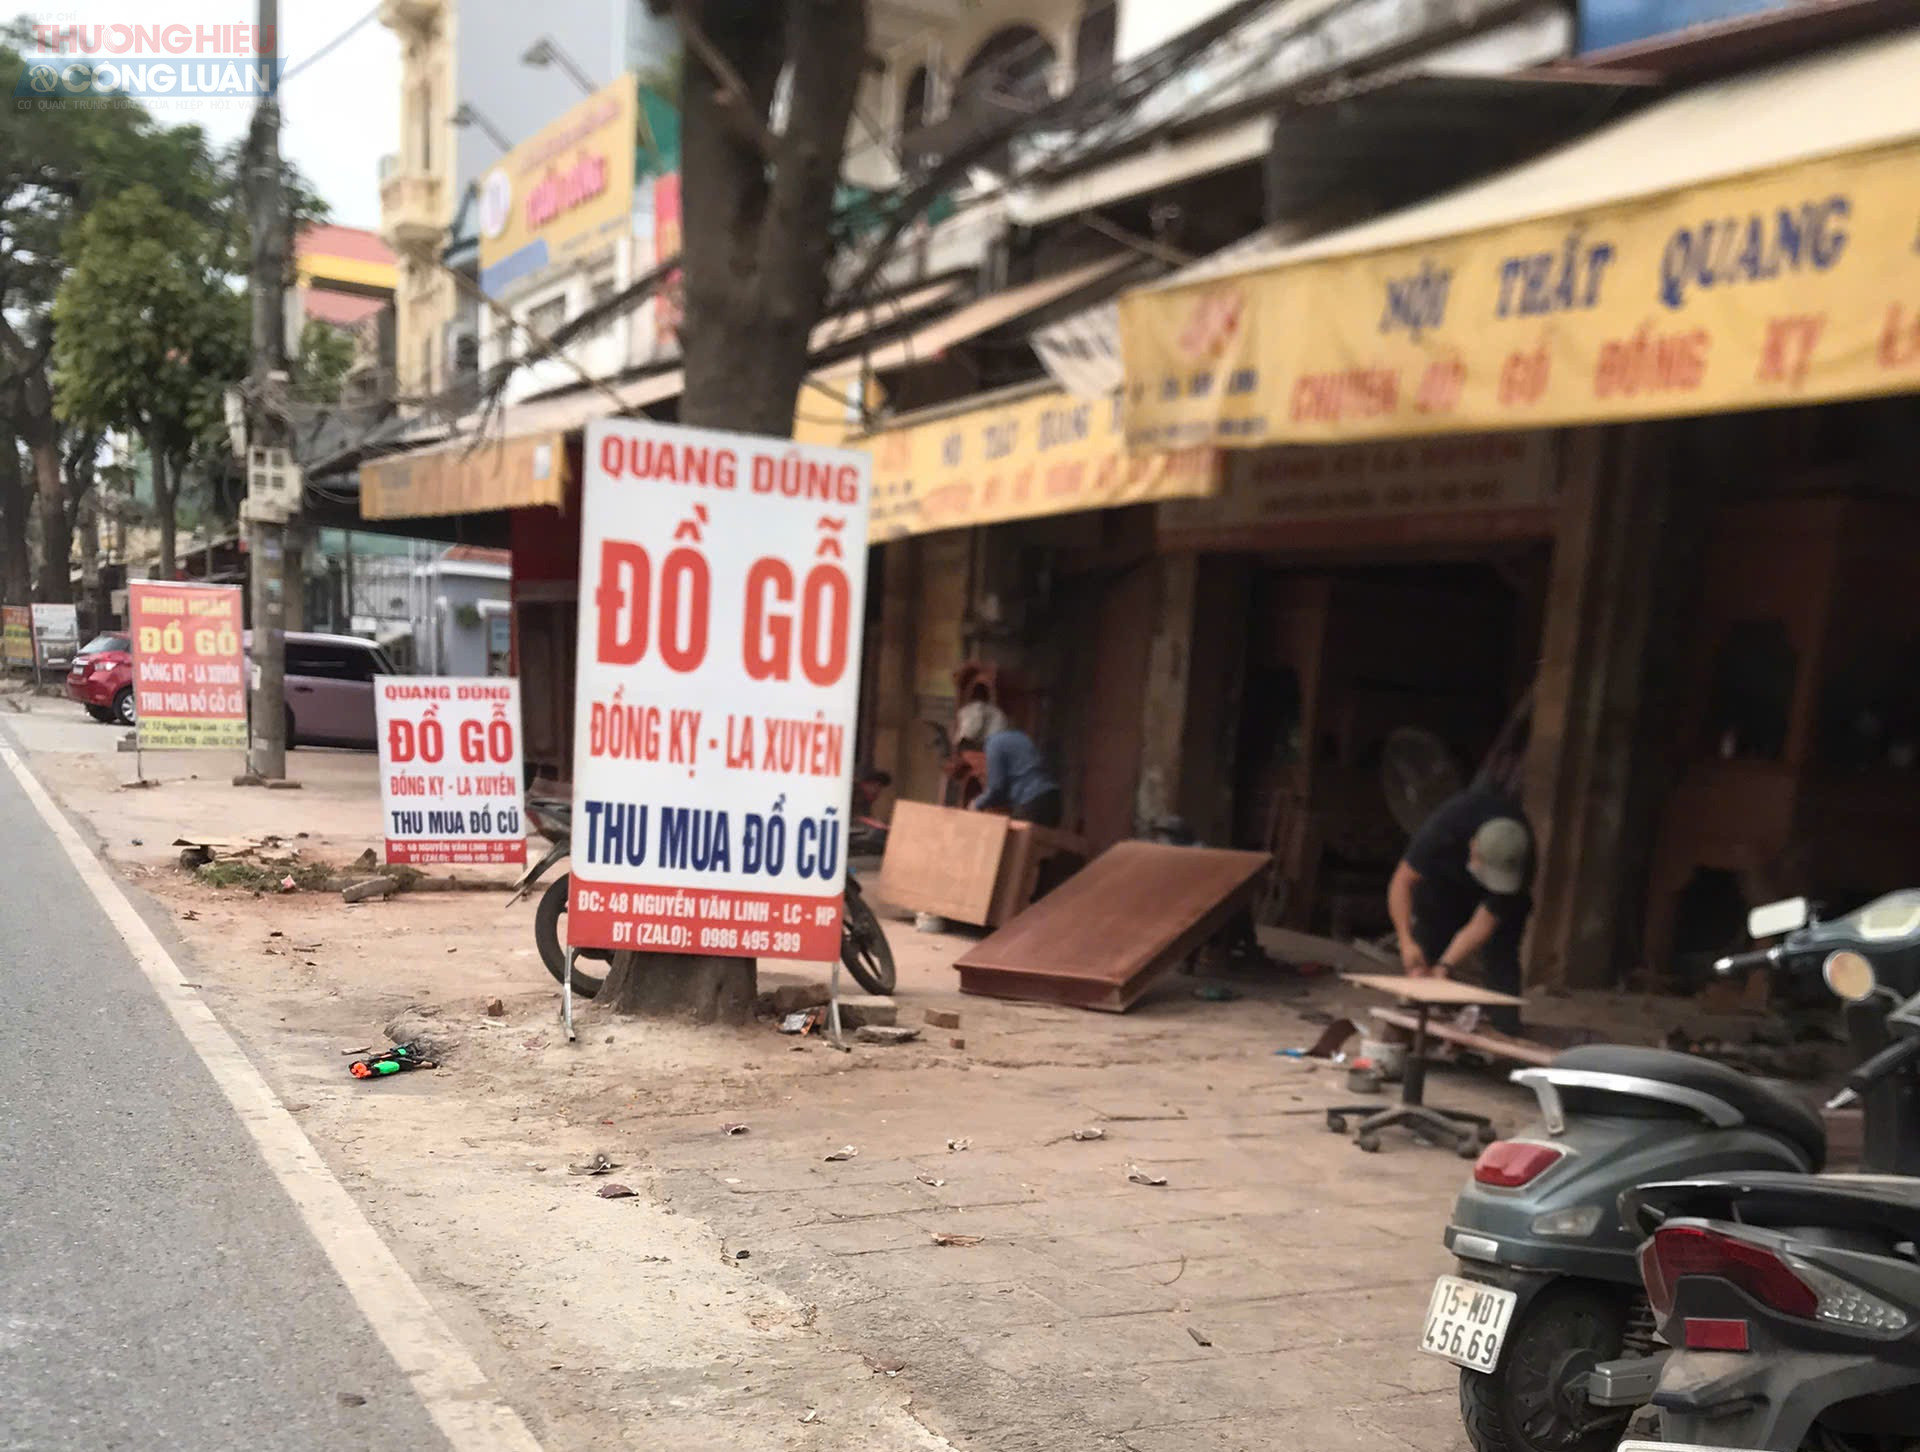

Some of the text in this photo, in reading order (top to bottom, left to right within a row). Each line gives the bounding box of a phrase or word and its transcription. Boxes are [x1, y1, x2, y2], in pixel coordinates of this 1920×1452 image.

[1658, 195, 1854, 310] QUANG
[601, 435, 738, 491] QUANG
[751, 450, 860, 505] DŨNG
[595, 503, 852, 688] ĐỒ GỖ
[385, 685, 450, 700] QUANG
[388, 703, 514, 763] ĐỒ GỖ
[726, 714, 755, 771] LA
[762, 710, 844, 777] XUYÊN
[457, 776, 472, 796] LA
[391, 811, 423, 834] THU
[428, 811, 466, 834] MUA
[497, 806, 519, 834] CŨ
[585, 800, 648, 868] THU
[659, 806, 731, 873] MUA
[797, 807, 840, 881] CŨ
[578, 890, 605, 912] ĐC:
[608, 892, 628, 914] 48
[632, 889, 695, 918] NGUYỄN
[699, 894, 731, 920] VĂN
[734, 900, 770, 922] LINH
[783, 904, 803, 924] LC
[815, 905, 837, 927] HP
[612, 921, 633, 942] ĐT
[701, 927, 738, 949] 0986
[741, 929, 770, 950] 495
[1426, 1317, 1498, 1365] 456.69
